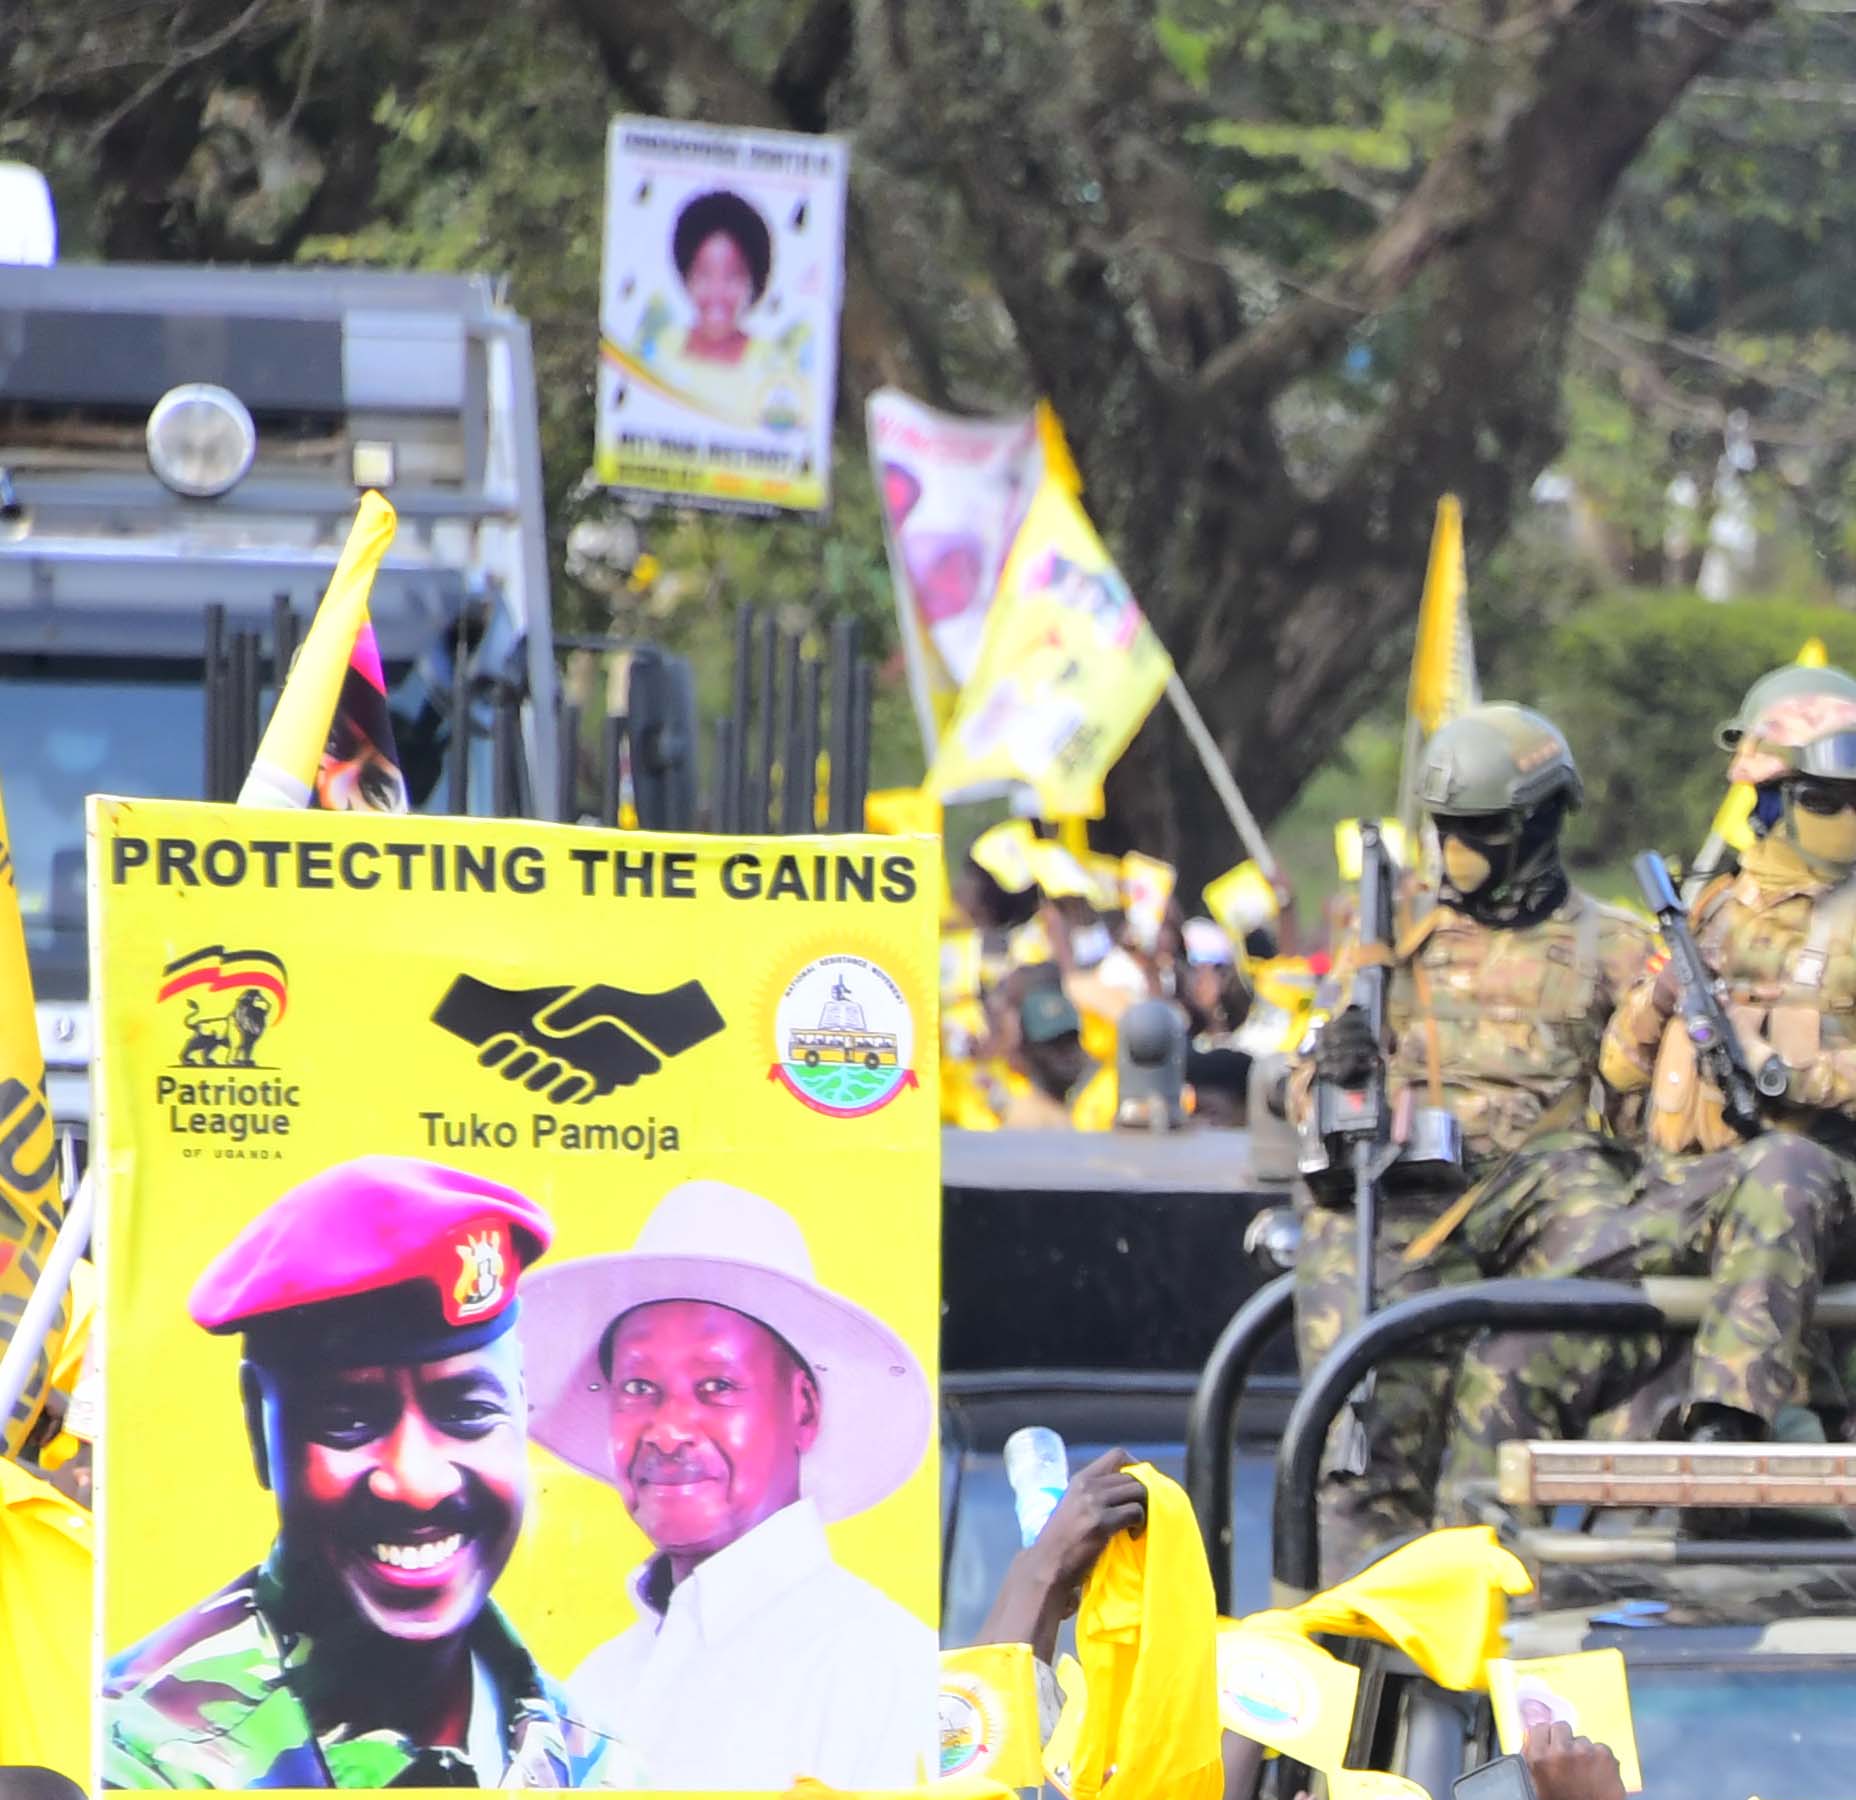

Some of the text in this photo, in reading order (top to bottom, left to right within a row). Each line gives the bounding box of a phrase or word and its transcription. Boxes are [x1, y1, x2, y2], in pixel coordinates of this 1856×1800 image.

[111, 836, 918, 904] PROTECTING THE GAINS
[156, 1075, 300, 1107] Patriotic
[169, 1105, 291, 1142] League
[419, 1112, 681, 1160] Tuko Pamoja
[183, 1148, 283, 1161] OF UGANDA
